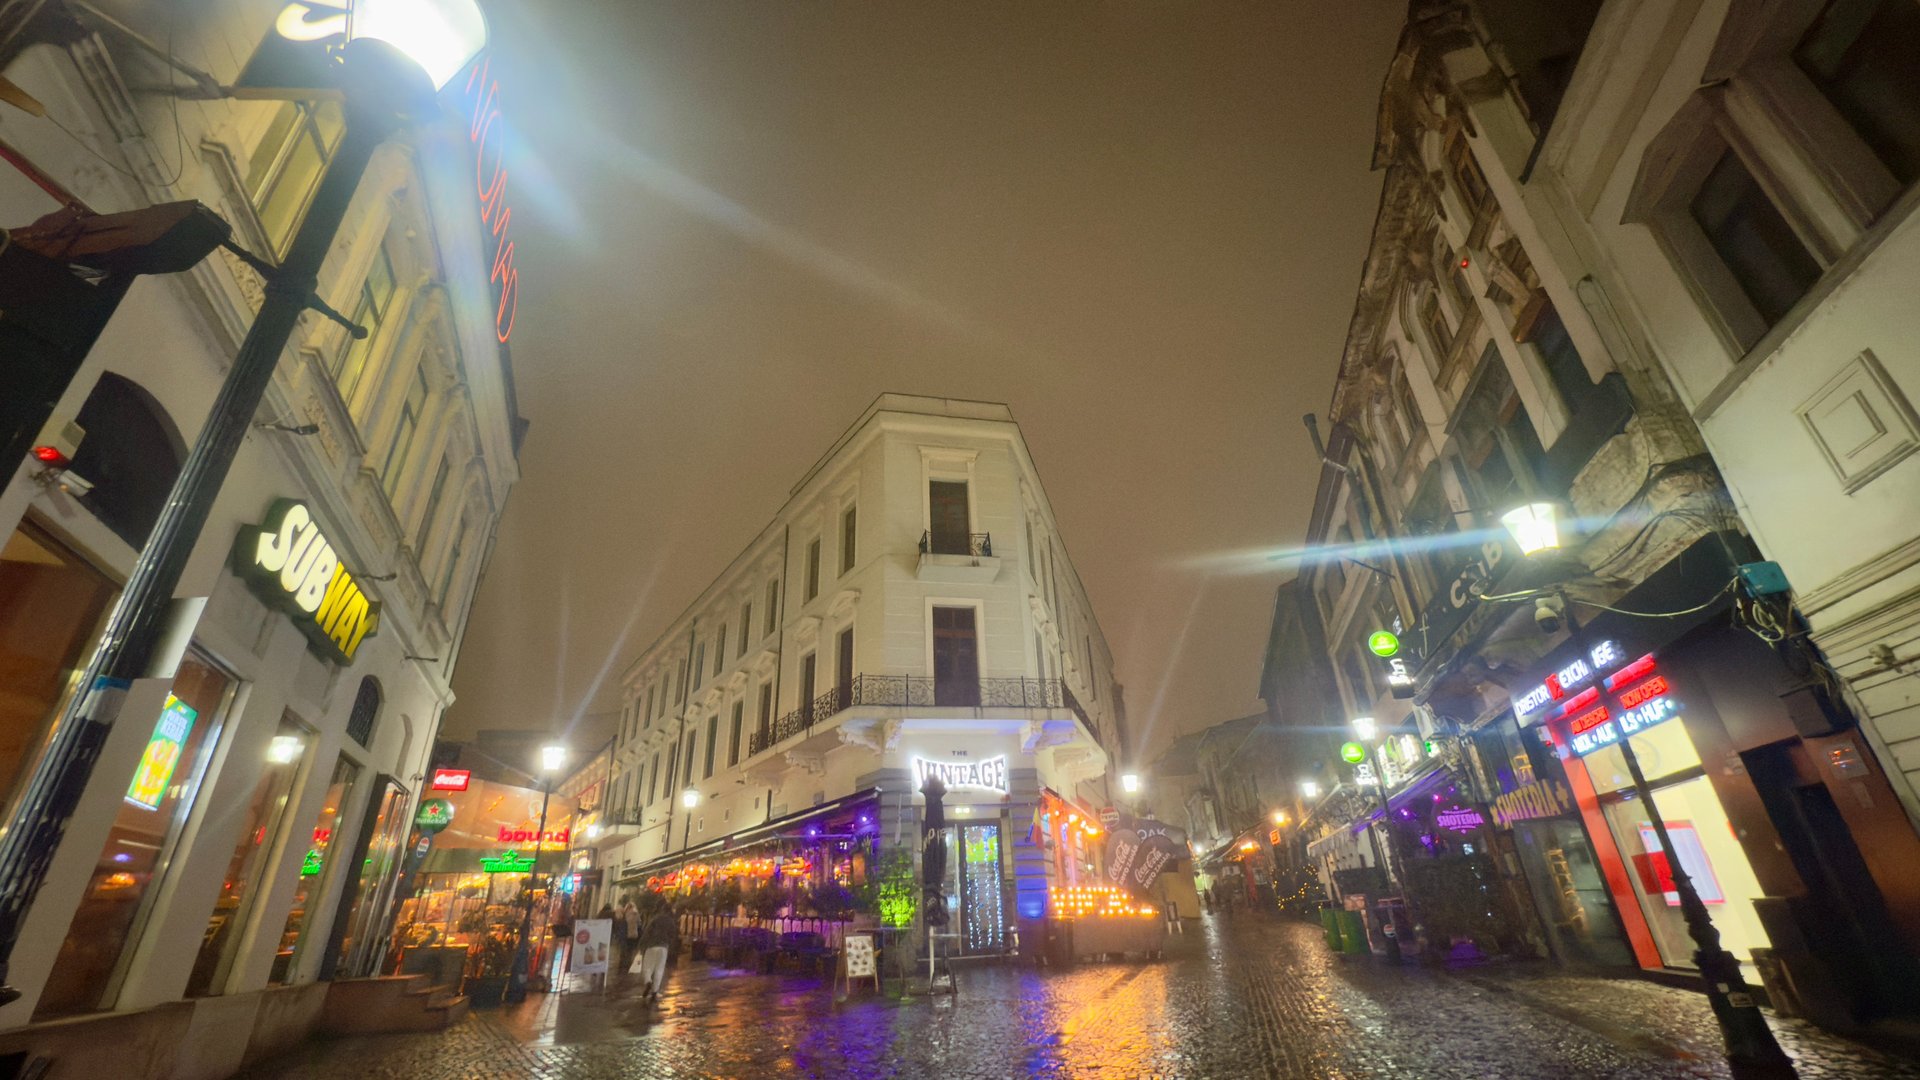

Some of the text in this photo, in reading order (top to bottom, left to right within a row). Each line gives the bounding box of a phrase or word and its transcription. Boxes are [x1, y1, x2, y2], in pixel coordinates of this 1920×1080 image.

[255, 504, 378, 658] SUBWAY
[1558, 640, 1617, 689] EXCHGE
[497, 824, 569, 843] bound
[1437, 812, 1484, 827] SHOTERIA
[1135, 846, 1163, 883] Coca-Cola
